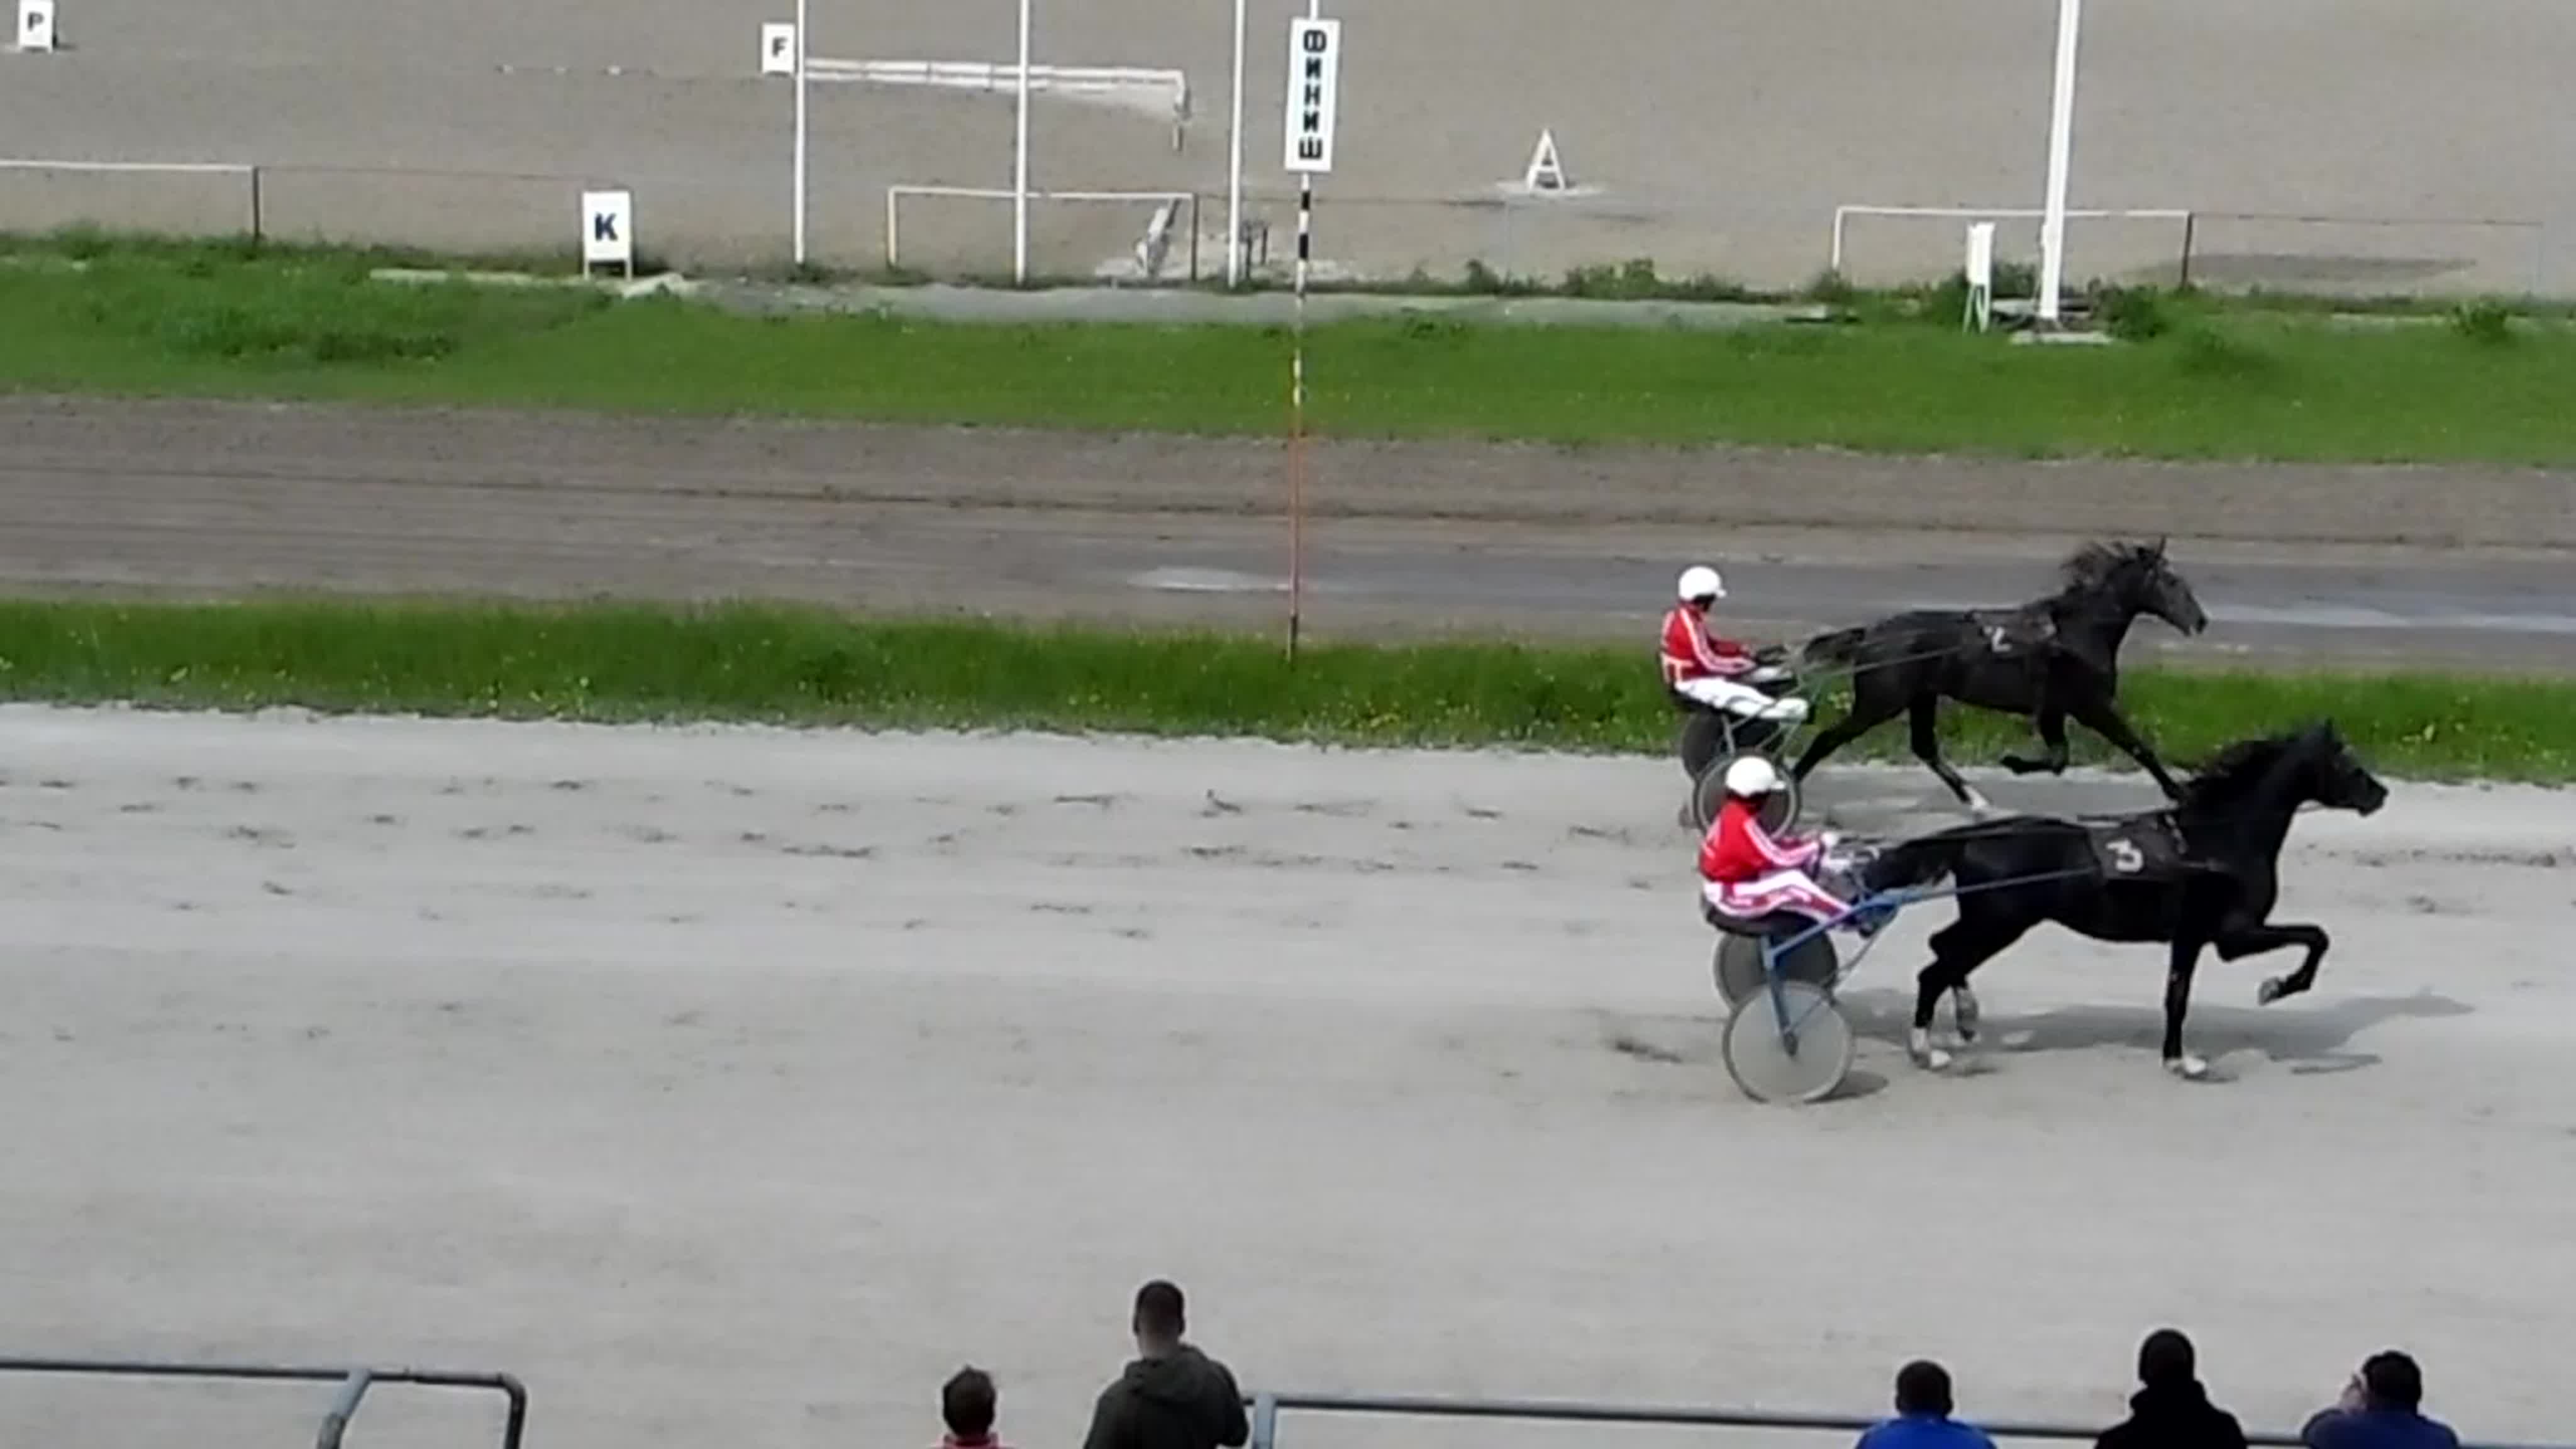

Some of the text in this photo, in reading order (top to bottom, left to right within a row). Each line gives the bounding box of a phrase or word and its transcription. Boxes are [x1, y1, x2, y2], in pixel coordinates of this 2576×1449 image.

[27, 11, 44, 31] P
[771, 37, 788, 57] F
[1298, 29, 1328, 160] ФИНИШ
[593, 213, 618, 242] K
[1984, 625, 2012, 653] 2
[2105, 839, 2144, 873] 3
